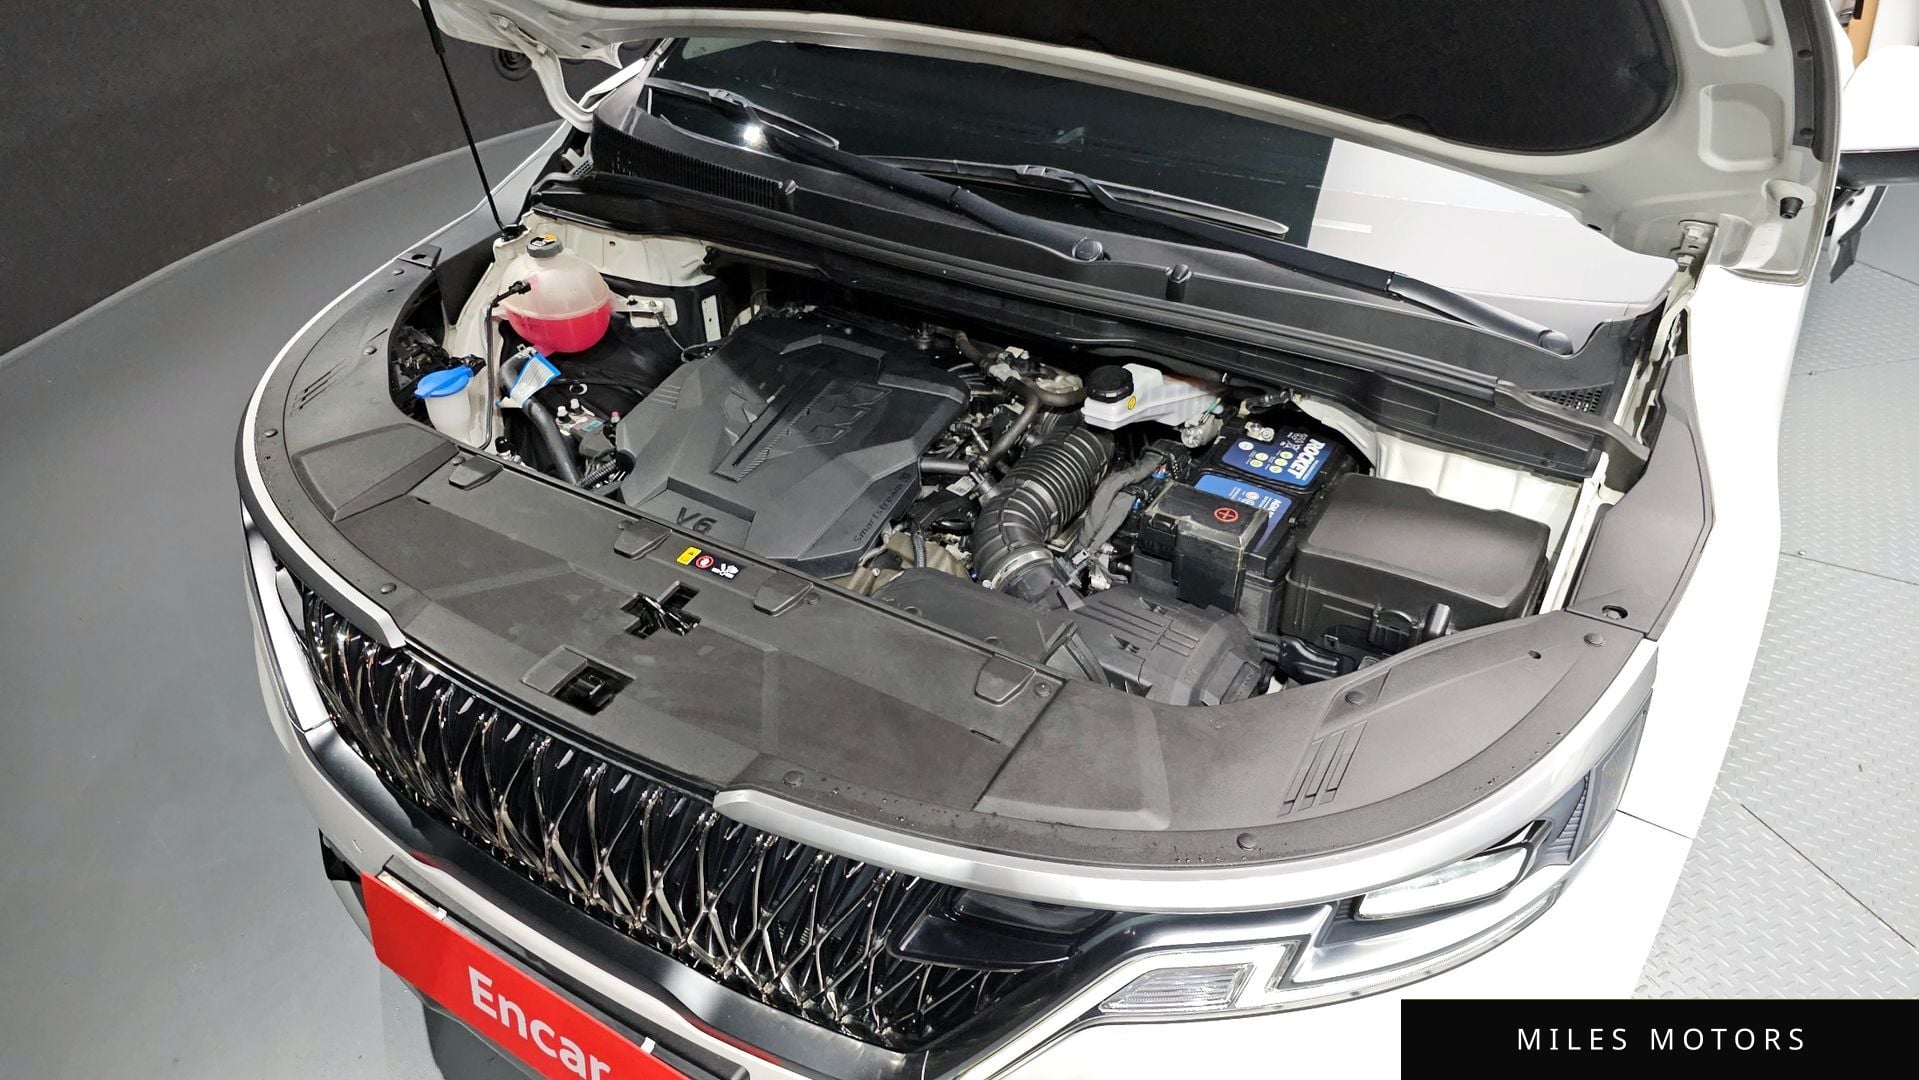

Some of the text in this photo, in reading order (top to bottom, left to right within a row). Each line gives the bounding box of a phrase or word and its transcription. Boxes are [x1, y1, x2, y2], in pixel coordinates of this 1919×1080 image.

[1287, 438, 1326, 480] ROCKET
[676, 506, 717, 533] V6
[853, 483, 904, 542] Smartstream
[468, 965, 611, 1080] Encar
